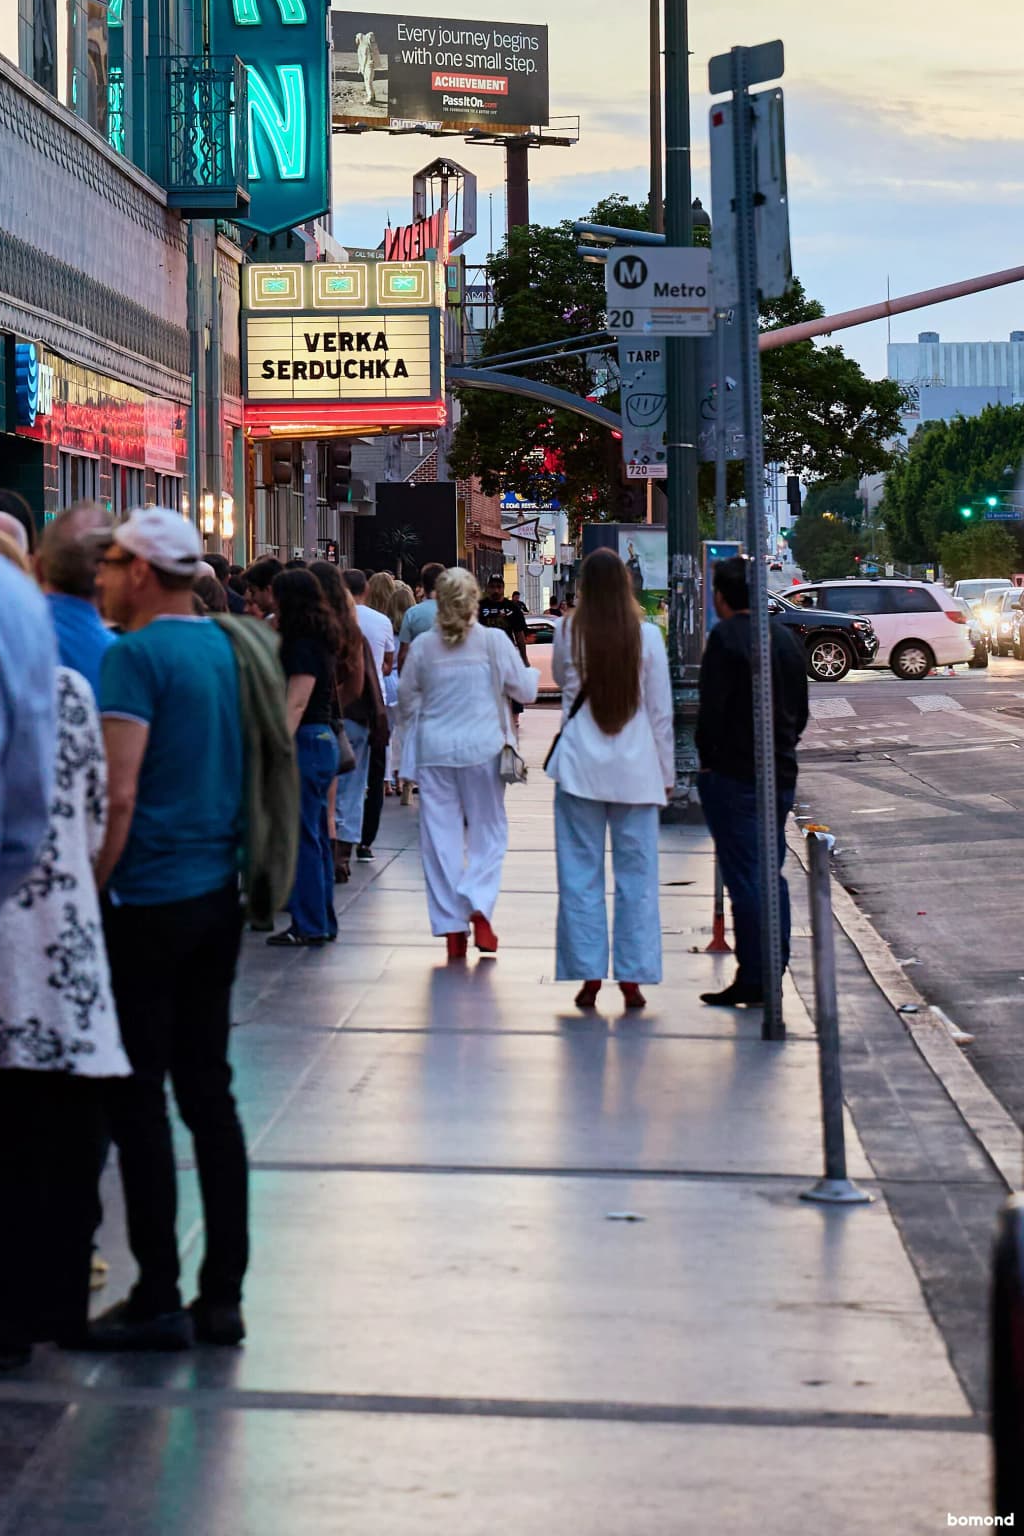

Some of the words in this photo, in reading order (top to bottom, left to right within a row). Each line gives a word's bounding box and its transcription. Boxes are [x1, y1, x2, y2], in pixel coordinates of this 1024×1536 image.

[397, 23, 436, 47] Every
[438, 26, 490, 50] journey
[493, 30, 539, 52] begins
[401, 47, 431, 65] with
[435, 51, 462, 67] one
[465, 52, 502, 70] small
[504, 55, 538, 75] step.
[434, 76, 506, 91] ACHIEVEMENT
[654, 283, 706, 298] Metro
[610, 311, 634, 328] 20
[304, 332, 389, 352] VERKA
[627, 351, 660, 363] TARP
[261, 359, 409, 380] SERDUCHKA
[629, 466, 648, 475] 720
